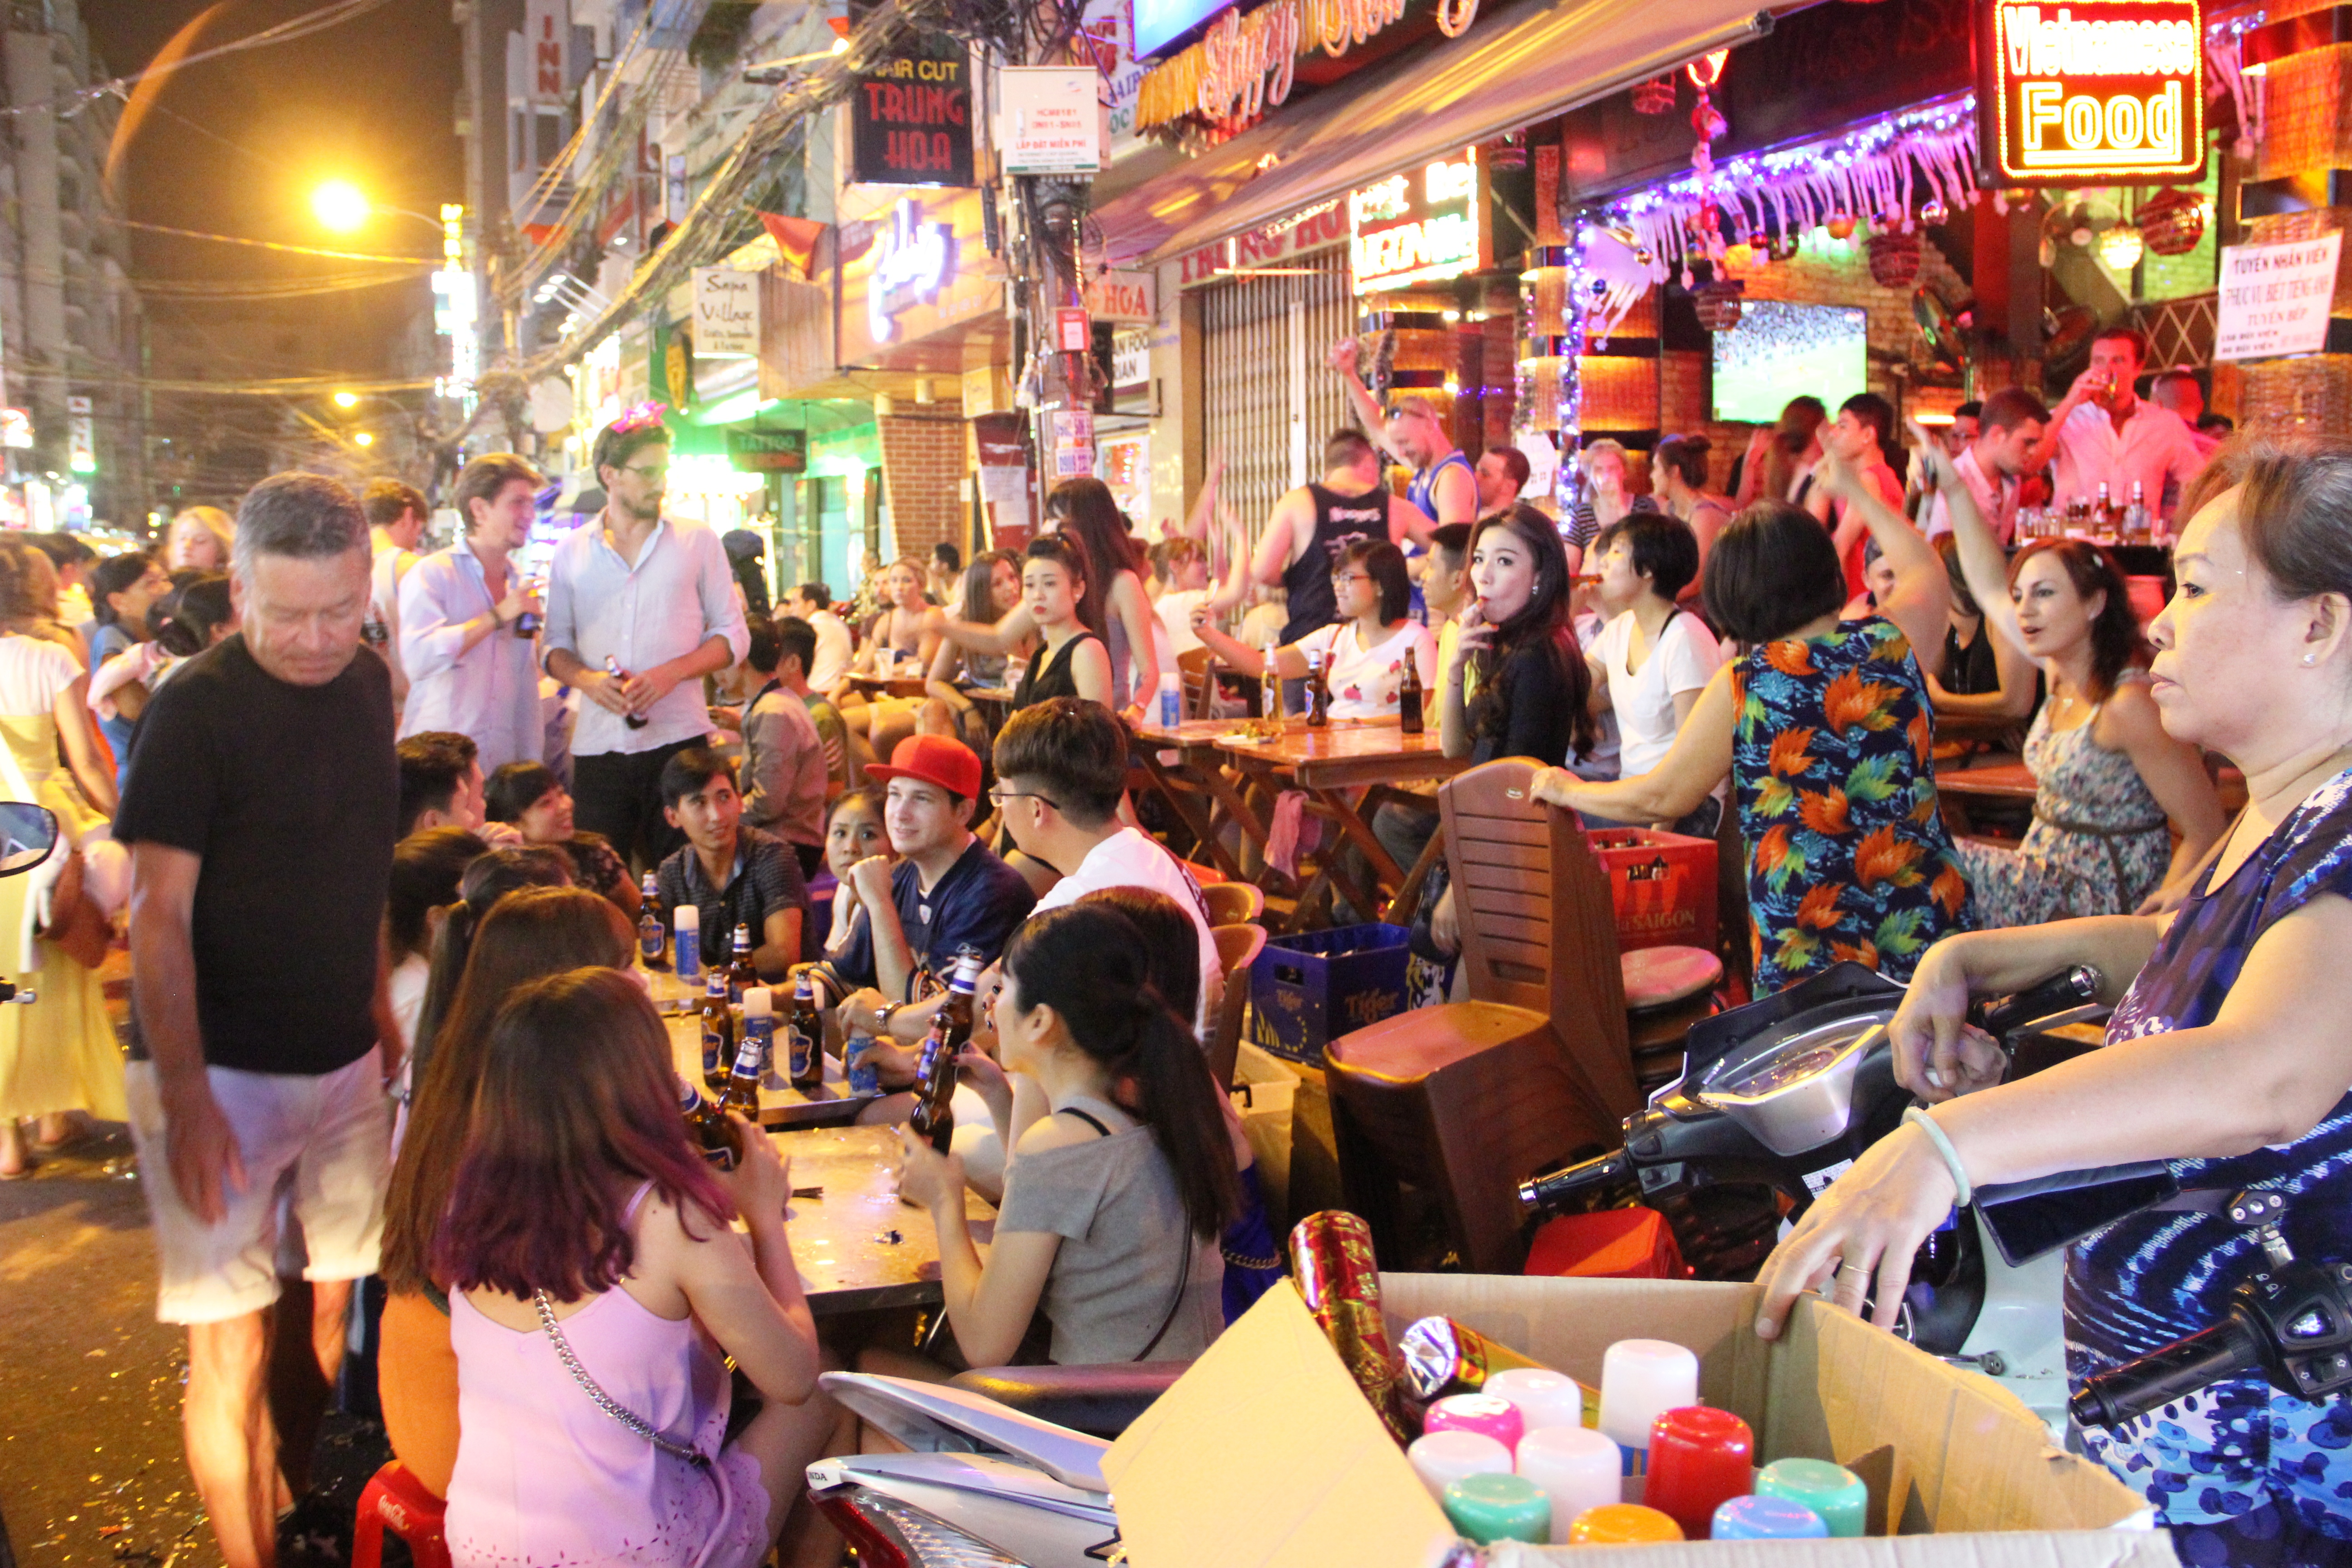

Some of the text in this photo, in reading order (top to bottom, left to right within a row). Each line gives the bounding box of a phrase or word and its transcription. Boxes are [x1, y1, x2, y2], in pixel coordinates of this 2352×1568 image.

[2003, 5, 2195, 76] Vietnamese
[918, 59, 959, 81] CUT
[864, 82, 964, 125] TRUNG
[2020, 80, 2183, 152] Food
[884, 131, 951, 171] HOA
[1103, 283, 1148, 317] HOA
[1633, 909, 1695, 930] SAIGON
[1344, 988, 1400, 1024] Tiger
